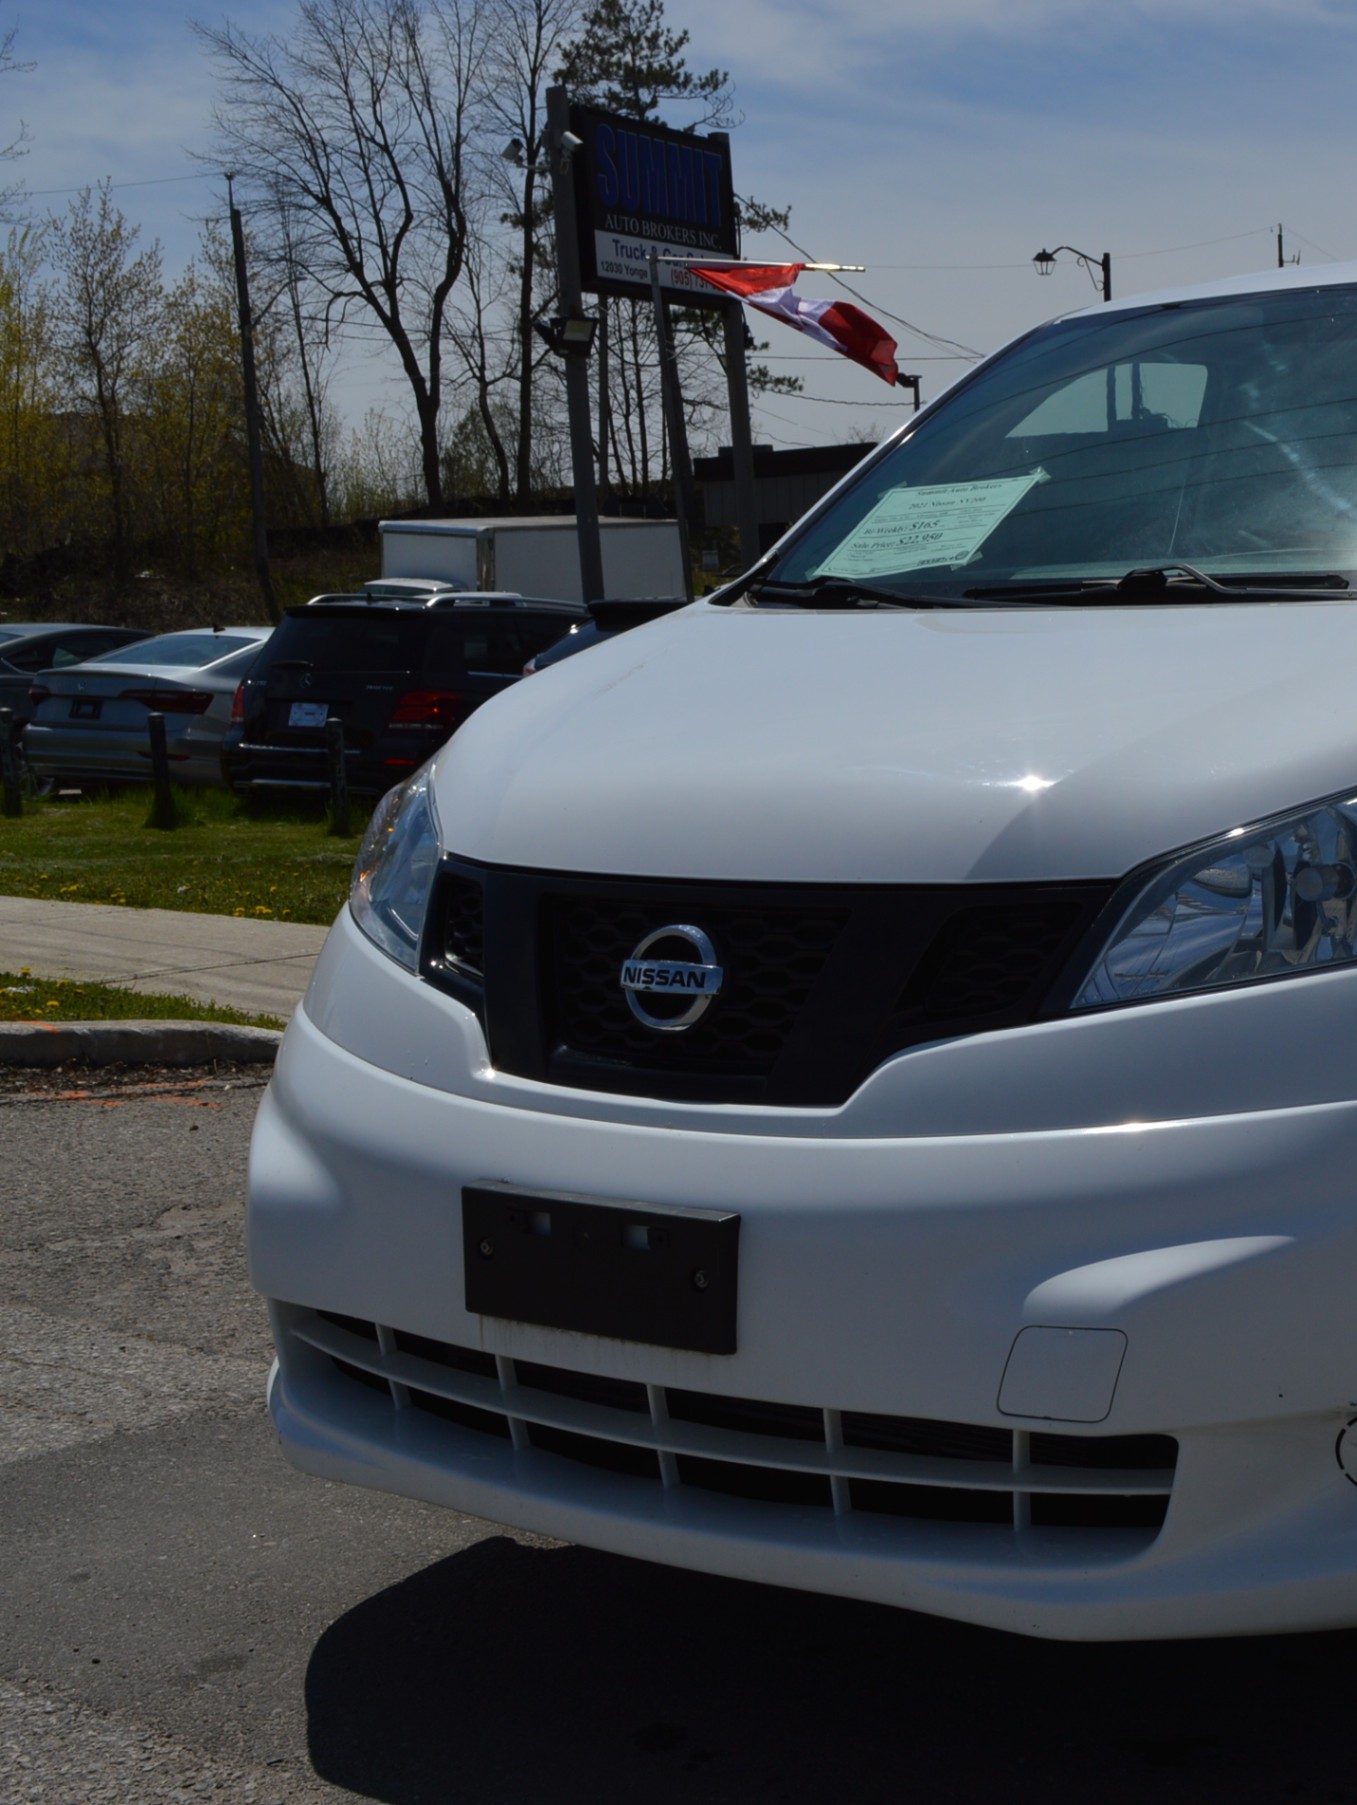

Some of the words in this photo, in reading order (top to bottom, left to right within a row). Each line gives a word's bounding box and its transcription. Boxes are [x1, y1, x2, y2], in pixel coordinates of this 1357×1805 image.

[596, 123, 722, 226] SUMMIT
[605, 214, 639, 234] AUTO
[642, 220, 697, 245] BROKERS
[698, 231, 722, 250] INC.
[612, 239, 647, 261] Truck
[601, 261, 623, 275] 12030
[624, 264, 648, 280] Yonge
[910, 520, 941, 531] $165
[623, 966, 707, 989] NISSAN
